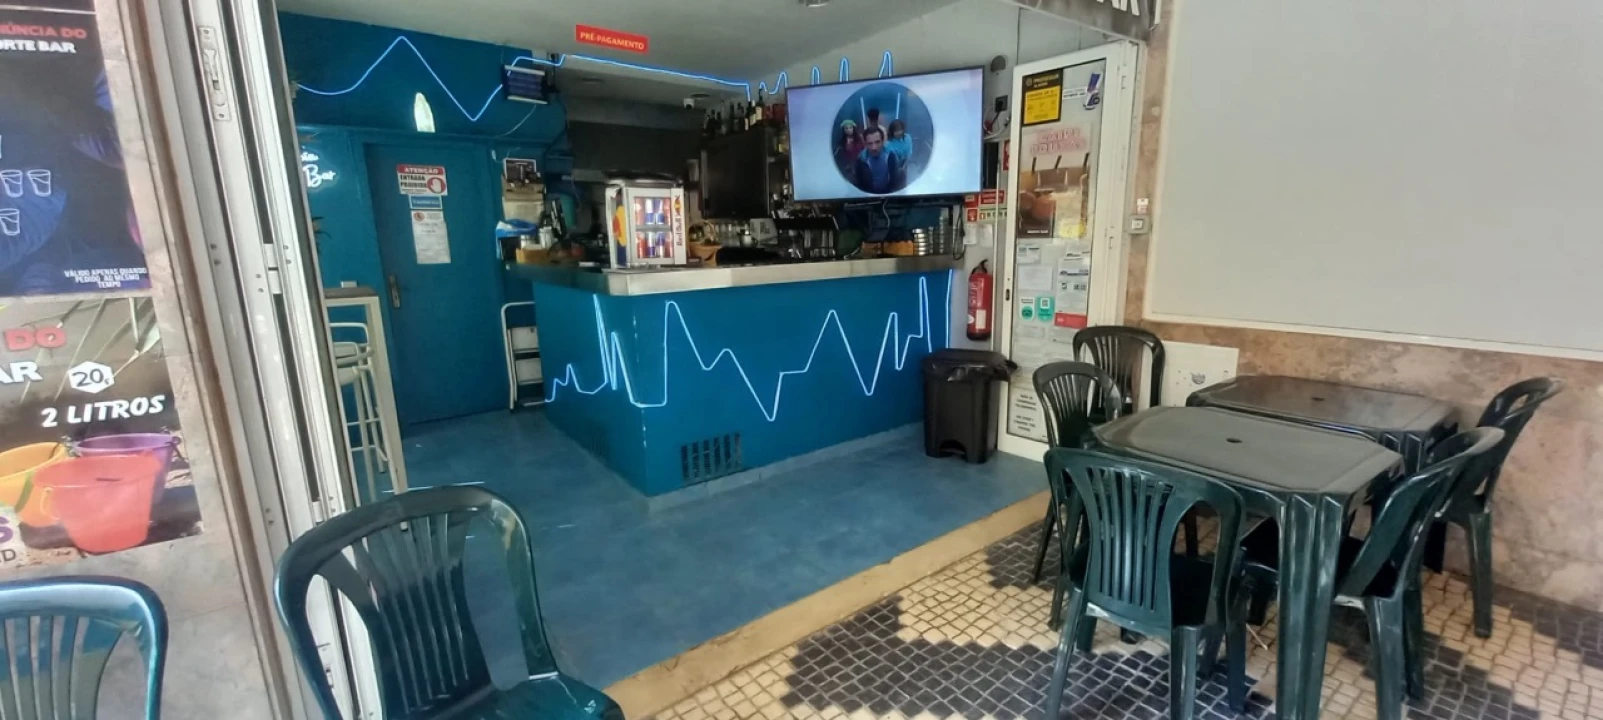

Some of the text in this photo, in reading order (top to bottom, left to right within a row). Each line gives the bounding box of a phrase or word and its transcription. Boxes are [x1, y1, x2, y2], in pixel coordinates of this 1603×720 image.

[61, 27, 87, 38] DO
[580, 31, 645, 50] PRÉ-PAGAMENTO
[38, 41, 76, 53] BAR
[302, 163, 337, 188] Bar
[75, 274, 101, 283] PEDIDO
[114, 273, 140, 281] MESMO
[5, 327, 66, 350] DO
[40, 394, 165, 428] 2 LITROS
